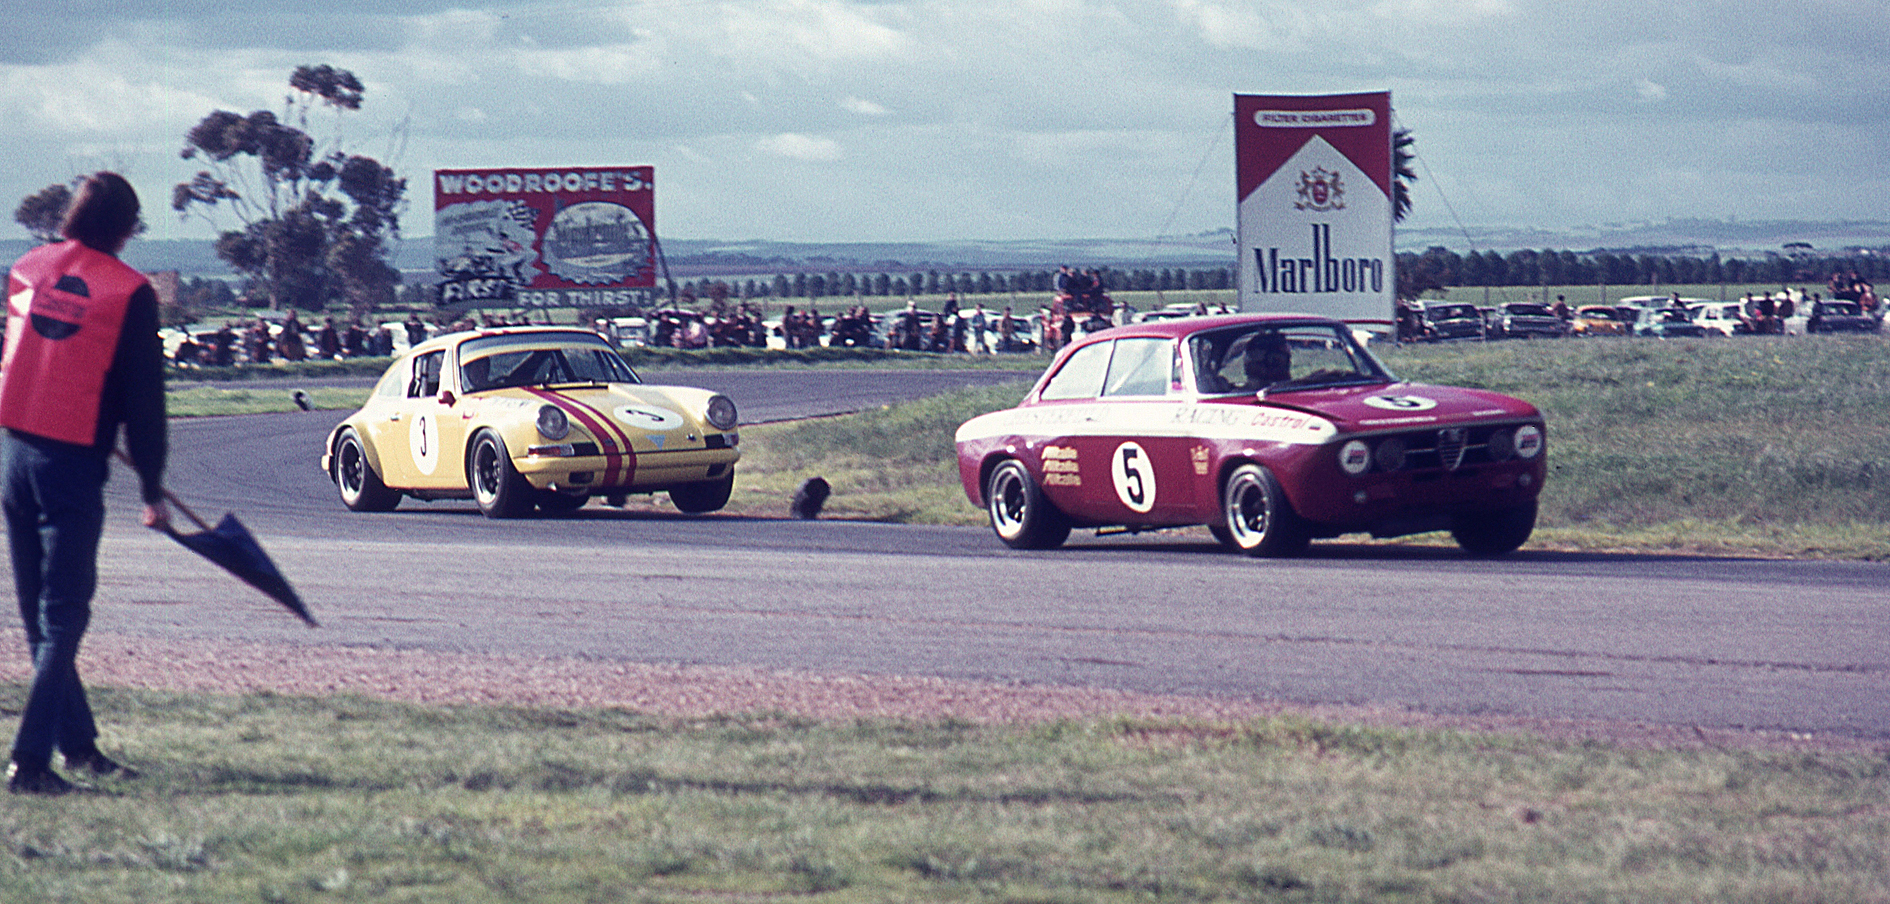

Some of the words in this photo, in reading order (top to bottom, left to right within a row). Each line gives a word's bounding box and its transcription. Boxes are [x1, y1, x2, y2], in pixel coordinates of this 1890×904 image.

[1252, 223, 1384, 294] Marlboro
[517, 290, 560, 306] FOR
[566, 289, 652, 306] THIRST!
[1380, 395, 1421, 408] 5
[625, 409, 665, 422] 3
[1171, 407, 1243, 426] RACING
[1250, 412, 1313, 429] Castrol
[419, 416, 427, 457] 3
[1122, 448, 1145, 505] 5
